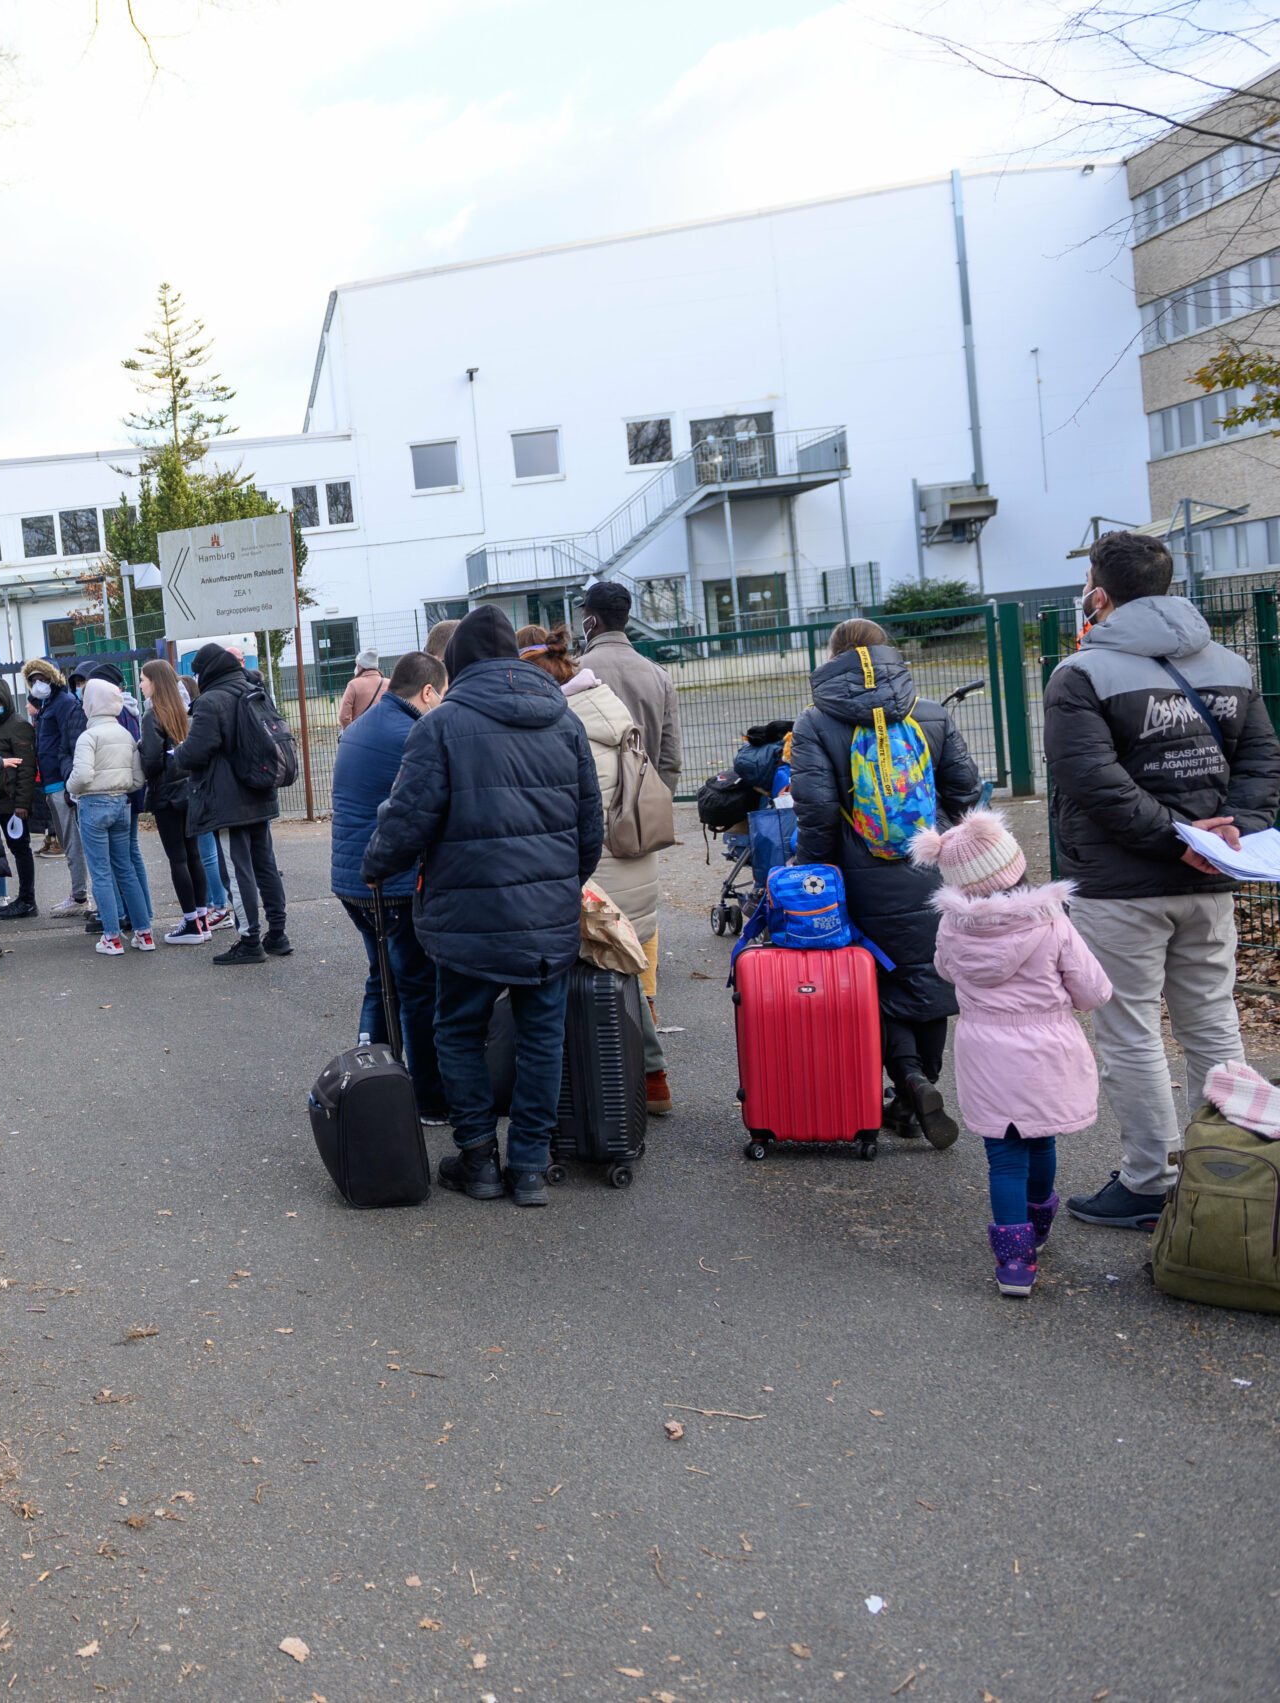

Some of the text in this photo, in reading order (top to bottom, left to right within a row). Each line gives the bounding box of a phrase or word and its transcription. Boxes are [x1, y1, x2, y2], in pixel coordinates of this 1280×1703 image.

[198, 551, 235, 563] Hamburg
[201, 568, 283, 584] Ankunftszentrum Rahlstedt
[233, 589, 247, 597] ZEA
[216, 602, 273, 616] Bargkoppelweg 66a
[1164, 747, 1206, 759] SEASON
[1143, 762, 1160, 771] ME
[1161, 758, 1204, 770] AGAINST
[1204, 755, 1220, 765] THE
